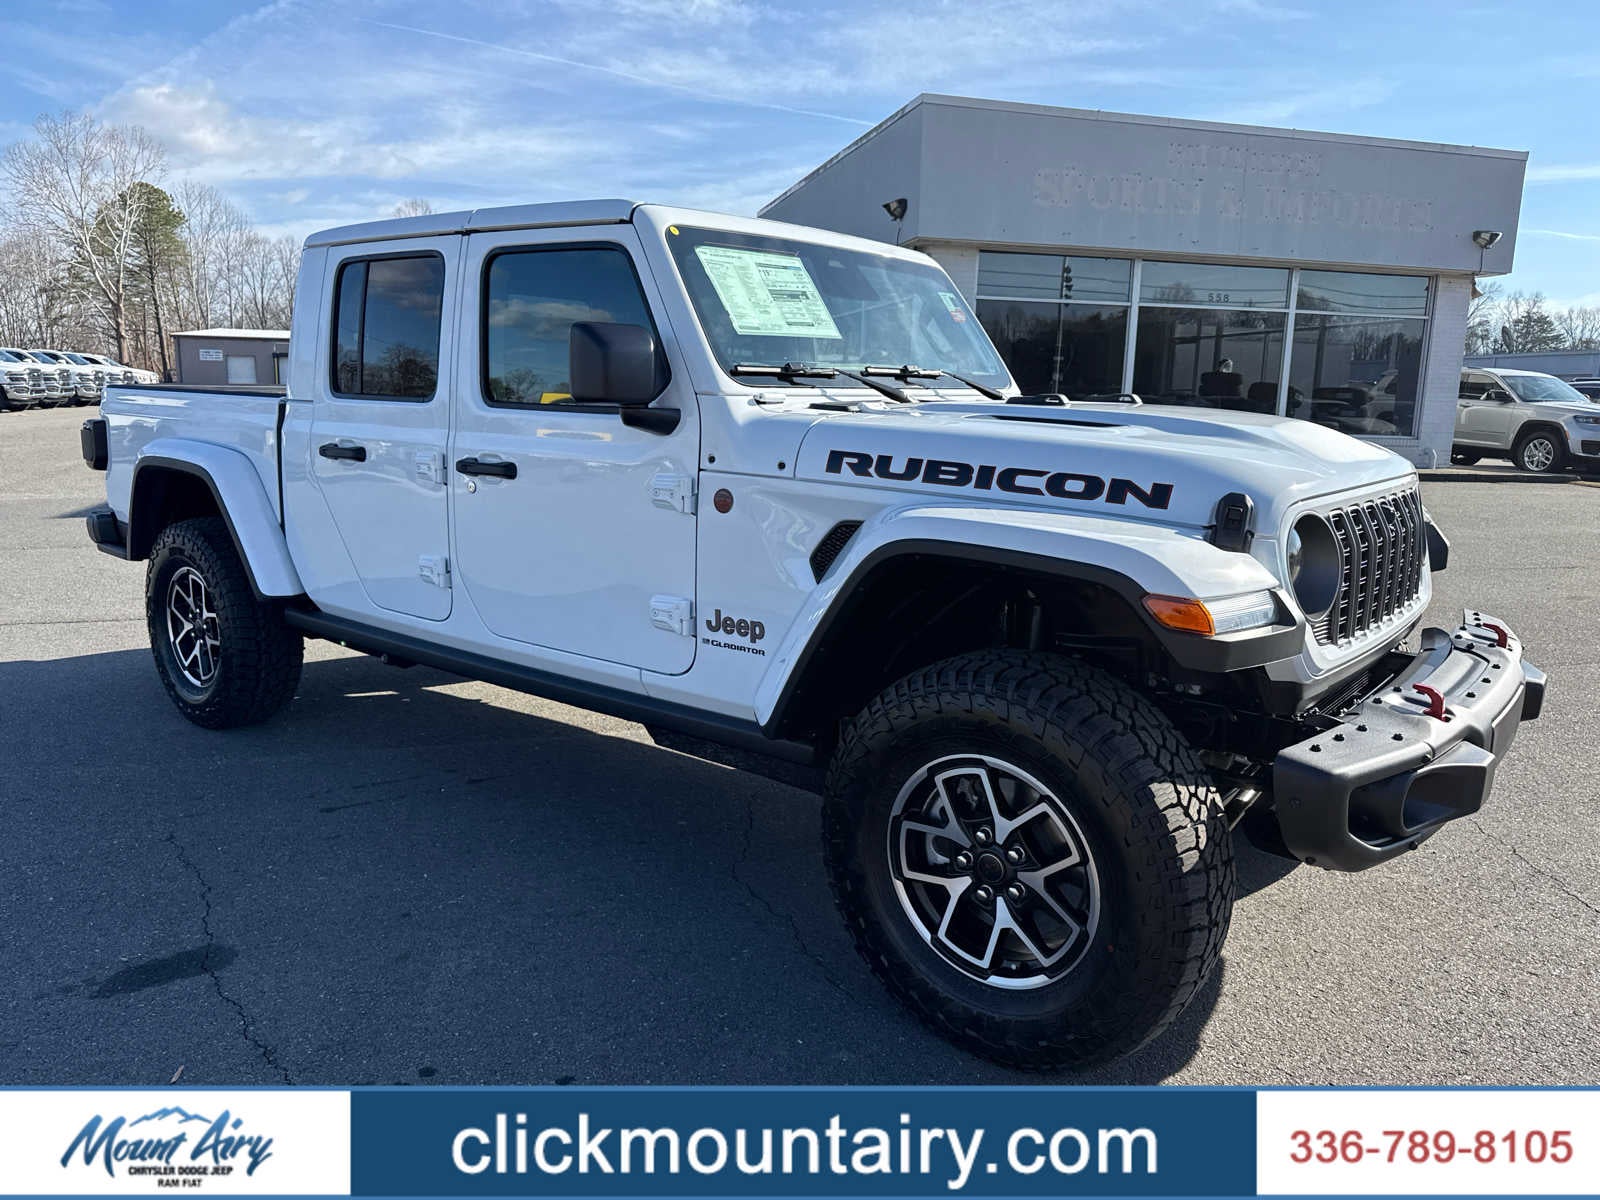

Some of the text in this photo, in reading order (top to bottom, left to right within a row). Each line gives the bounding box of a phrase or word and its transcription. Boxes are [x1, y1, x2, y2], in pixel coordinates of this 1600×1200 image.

[1208, 292, 1230, 304] 558
[825, 449, 1174, 510] RUBICON
[705, 608, 766, 644] Jeep
[710, 639, 766, 657] GLADIATOR
